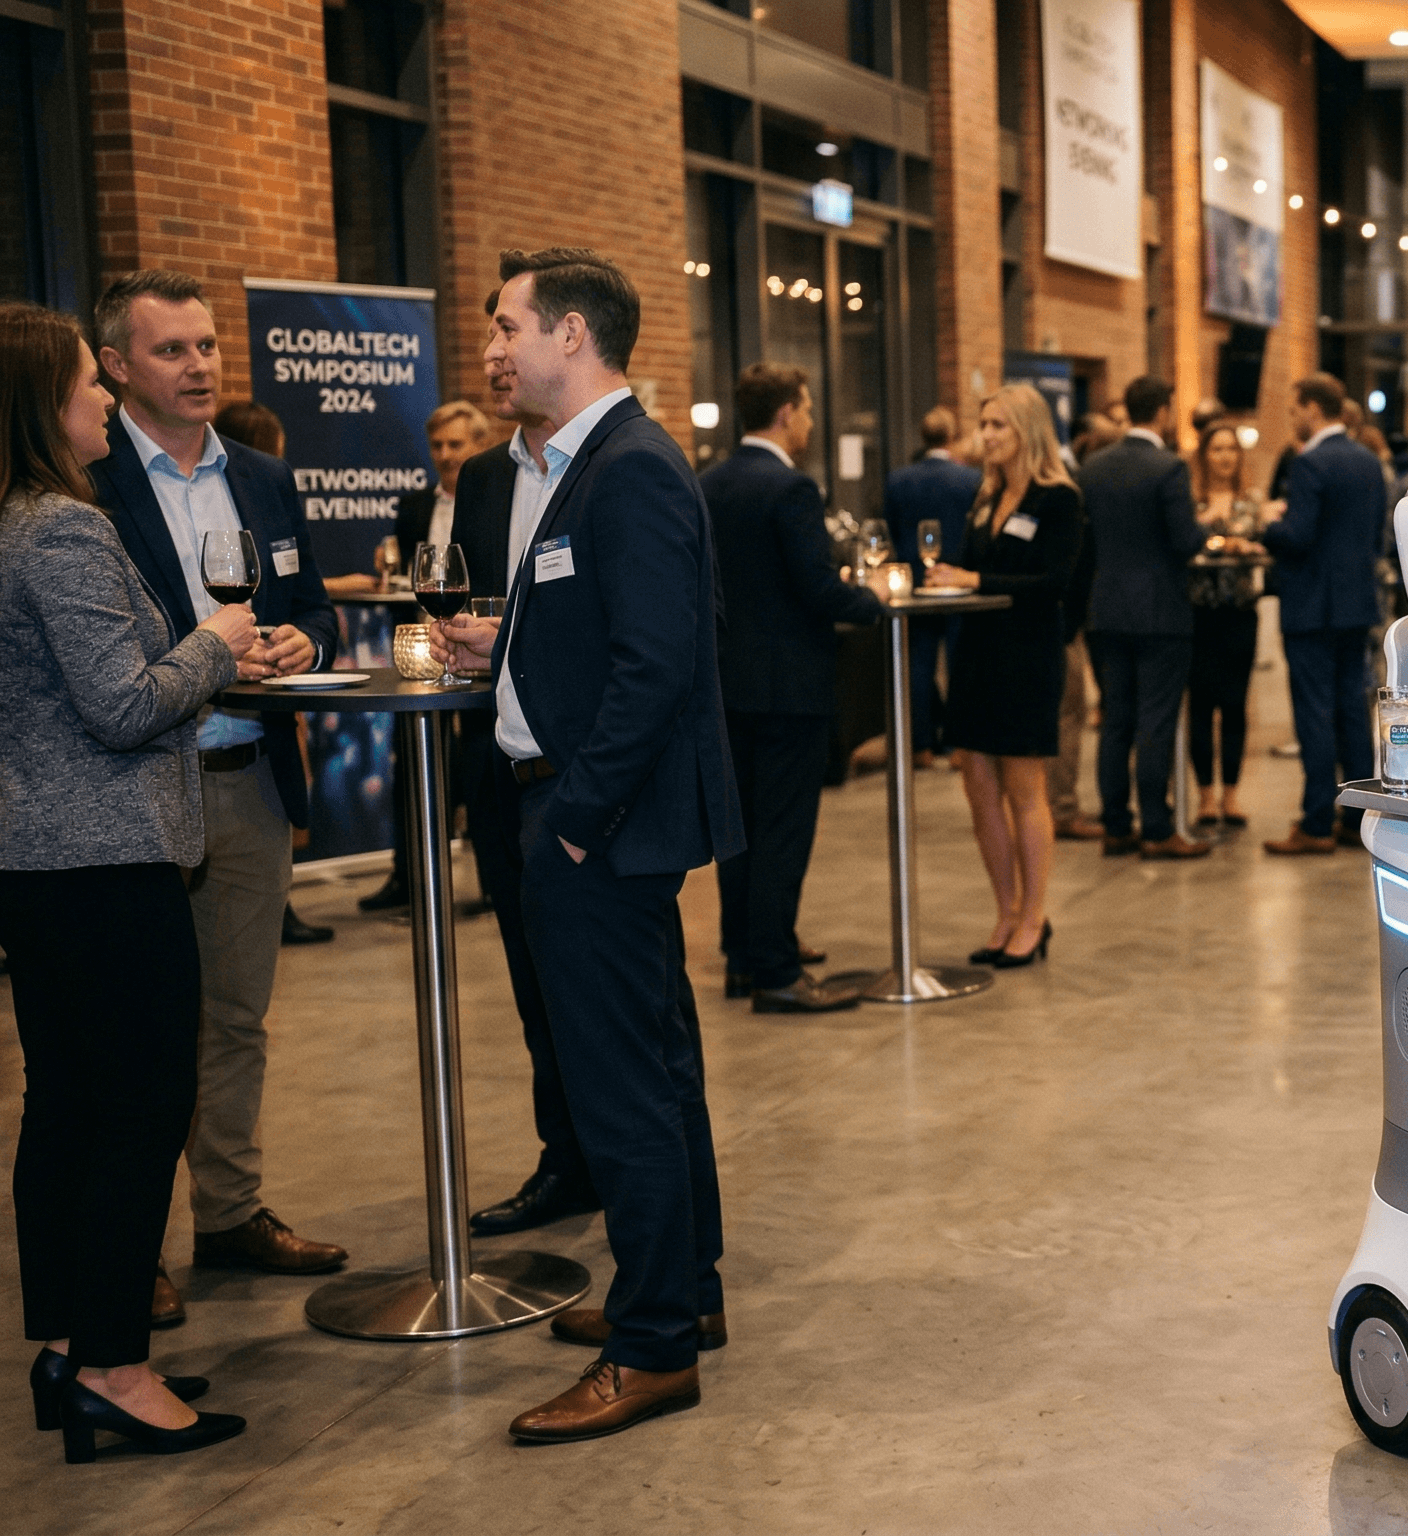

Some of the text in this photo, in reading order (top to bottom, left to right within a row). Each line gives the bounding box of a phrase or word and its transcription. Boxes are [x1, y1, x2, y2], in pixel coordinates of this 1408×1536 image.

[266, 326, 420, 358] GLOBALTECH
[274, 357, 415, 386] SYMPOSIUM
[319, 387, 377, 413] 2024
[293, 467, 427, 492] ETWORKING
